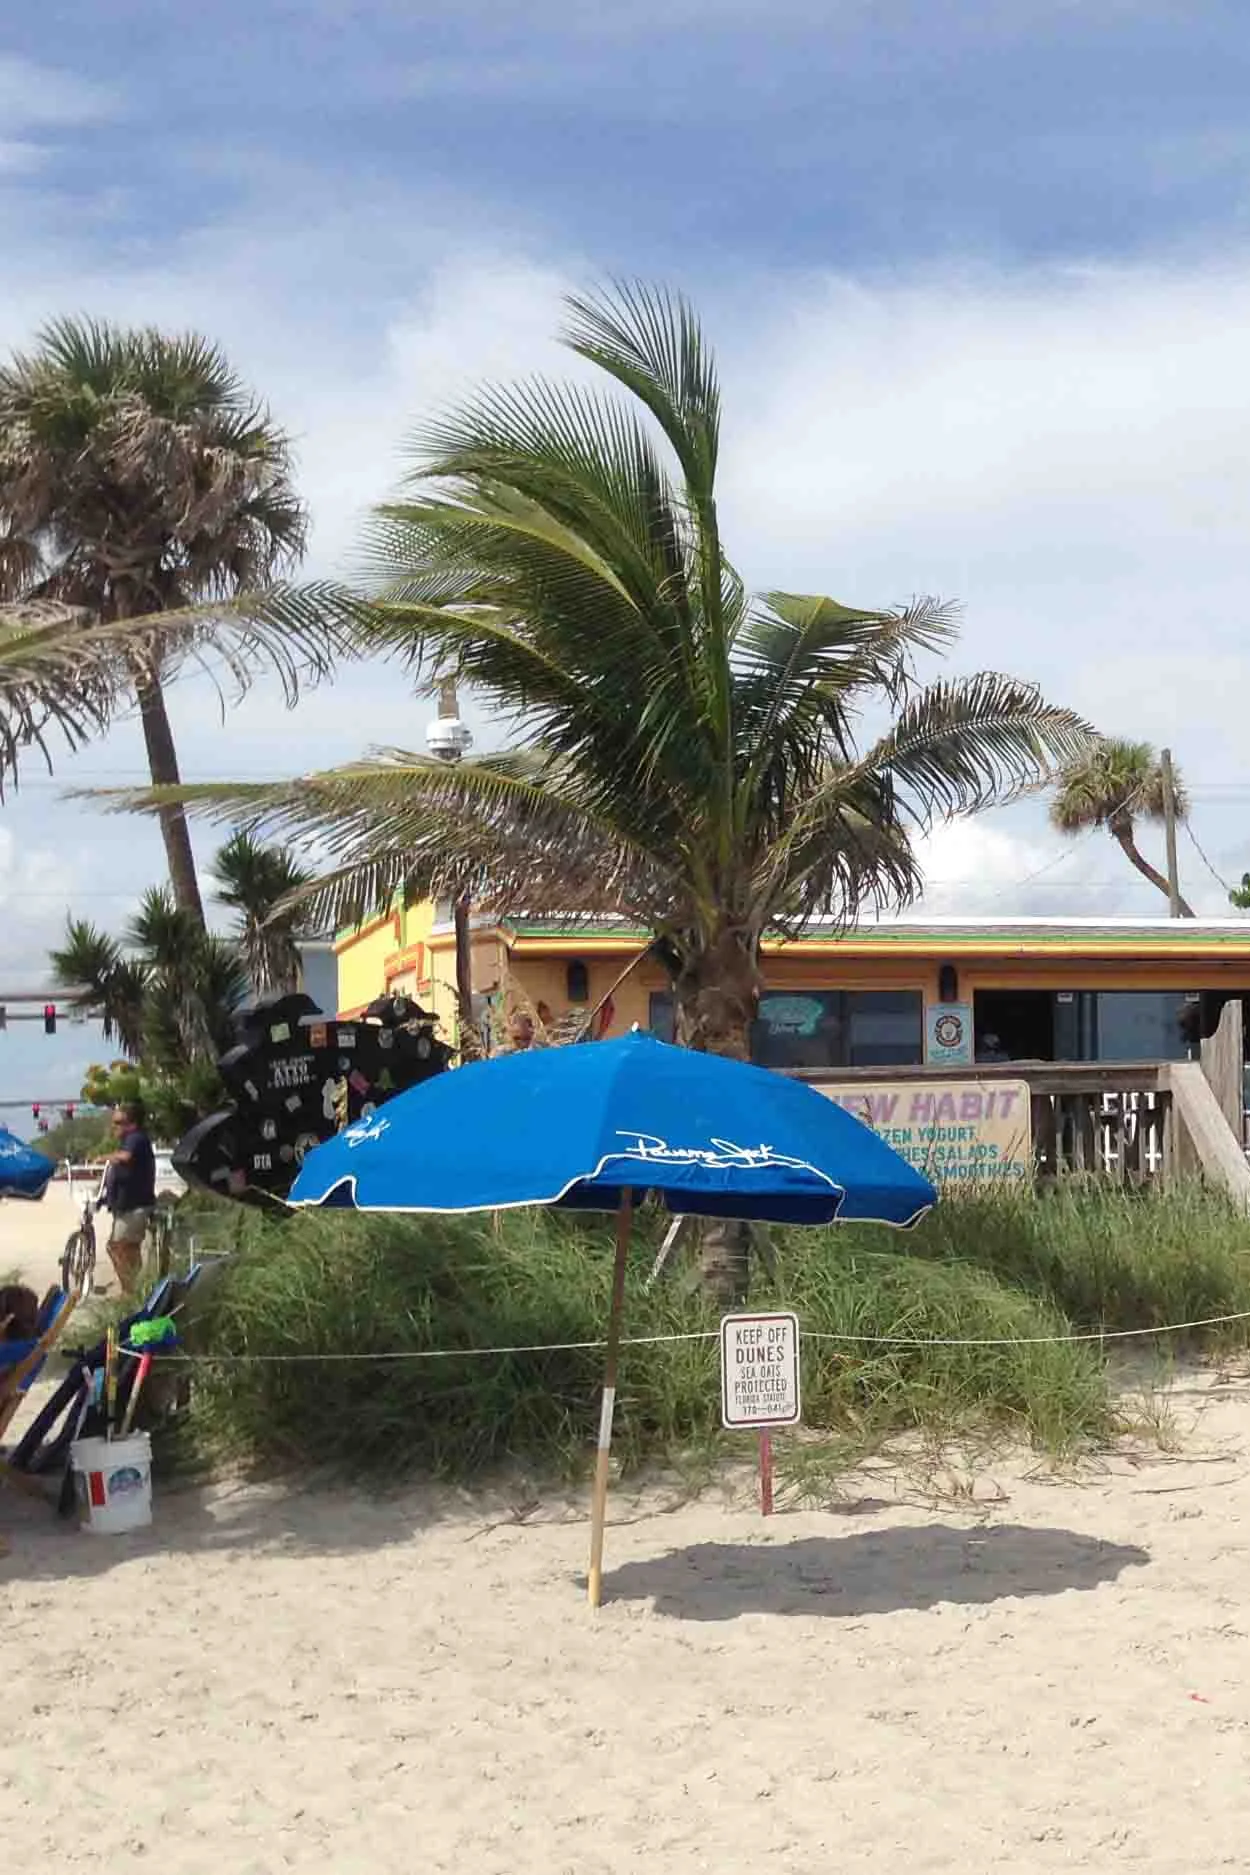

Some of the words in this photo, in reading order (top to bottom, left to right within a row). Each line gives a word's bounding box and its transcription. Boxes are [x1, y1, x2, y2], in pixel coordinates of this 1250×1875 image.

[834, 1093, 898, 1123] EW
[909, 1089, 1019, 1122] HABIT
[918, 1126, 976, 1142] YOGURT
[735, 1329, 763, 1345] KEEP
[768, 1327, 787, 1343] OFF
[735, 1345, 785, 1364] DUNES
[741, 1366, 756, 1379] SEA
[760, 1365, 781, 1378] OATS
[734, 1379, 788, 1394] PROTECTED
